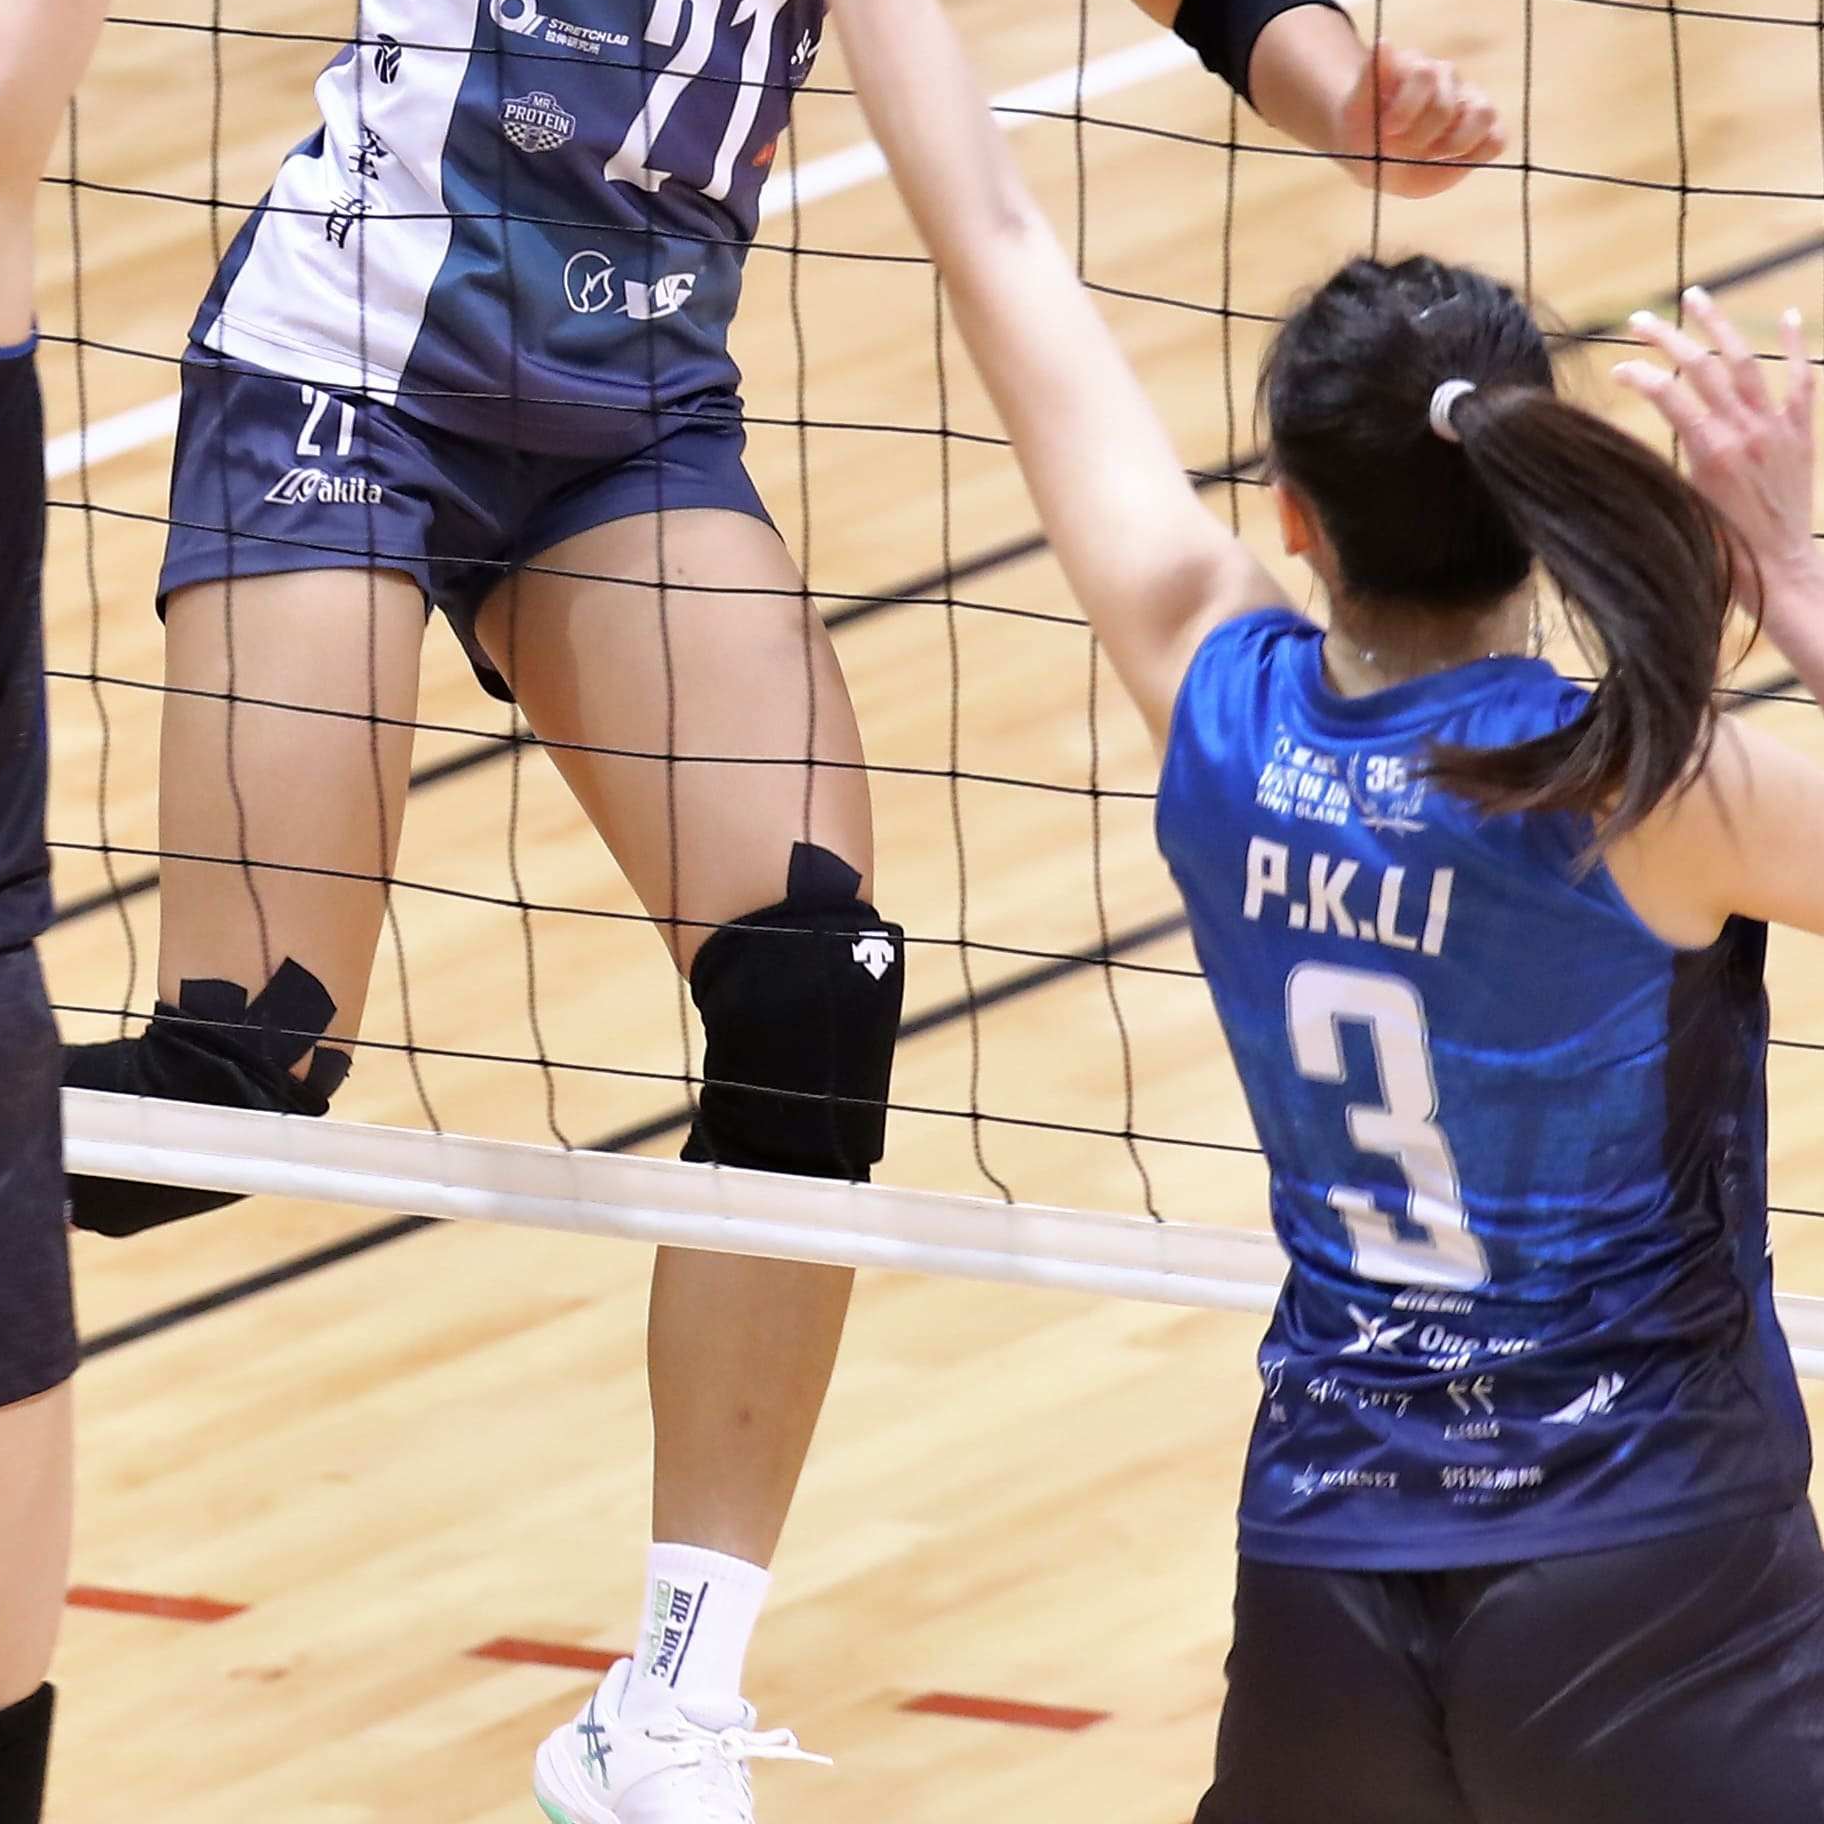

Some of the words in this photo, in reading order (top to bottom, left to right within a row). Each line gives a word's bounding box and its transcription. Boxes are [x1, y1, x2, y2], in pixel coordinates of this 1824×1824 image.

[504, 104, 570, 134] PROTEIN
[533, 95, 551, 108] MR
[296, 384, 358, 457] 21
[1242, 834, 1456, 958] P.K.LI
[1286, 962, 1490, 1290] 3
